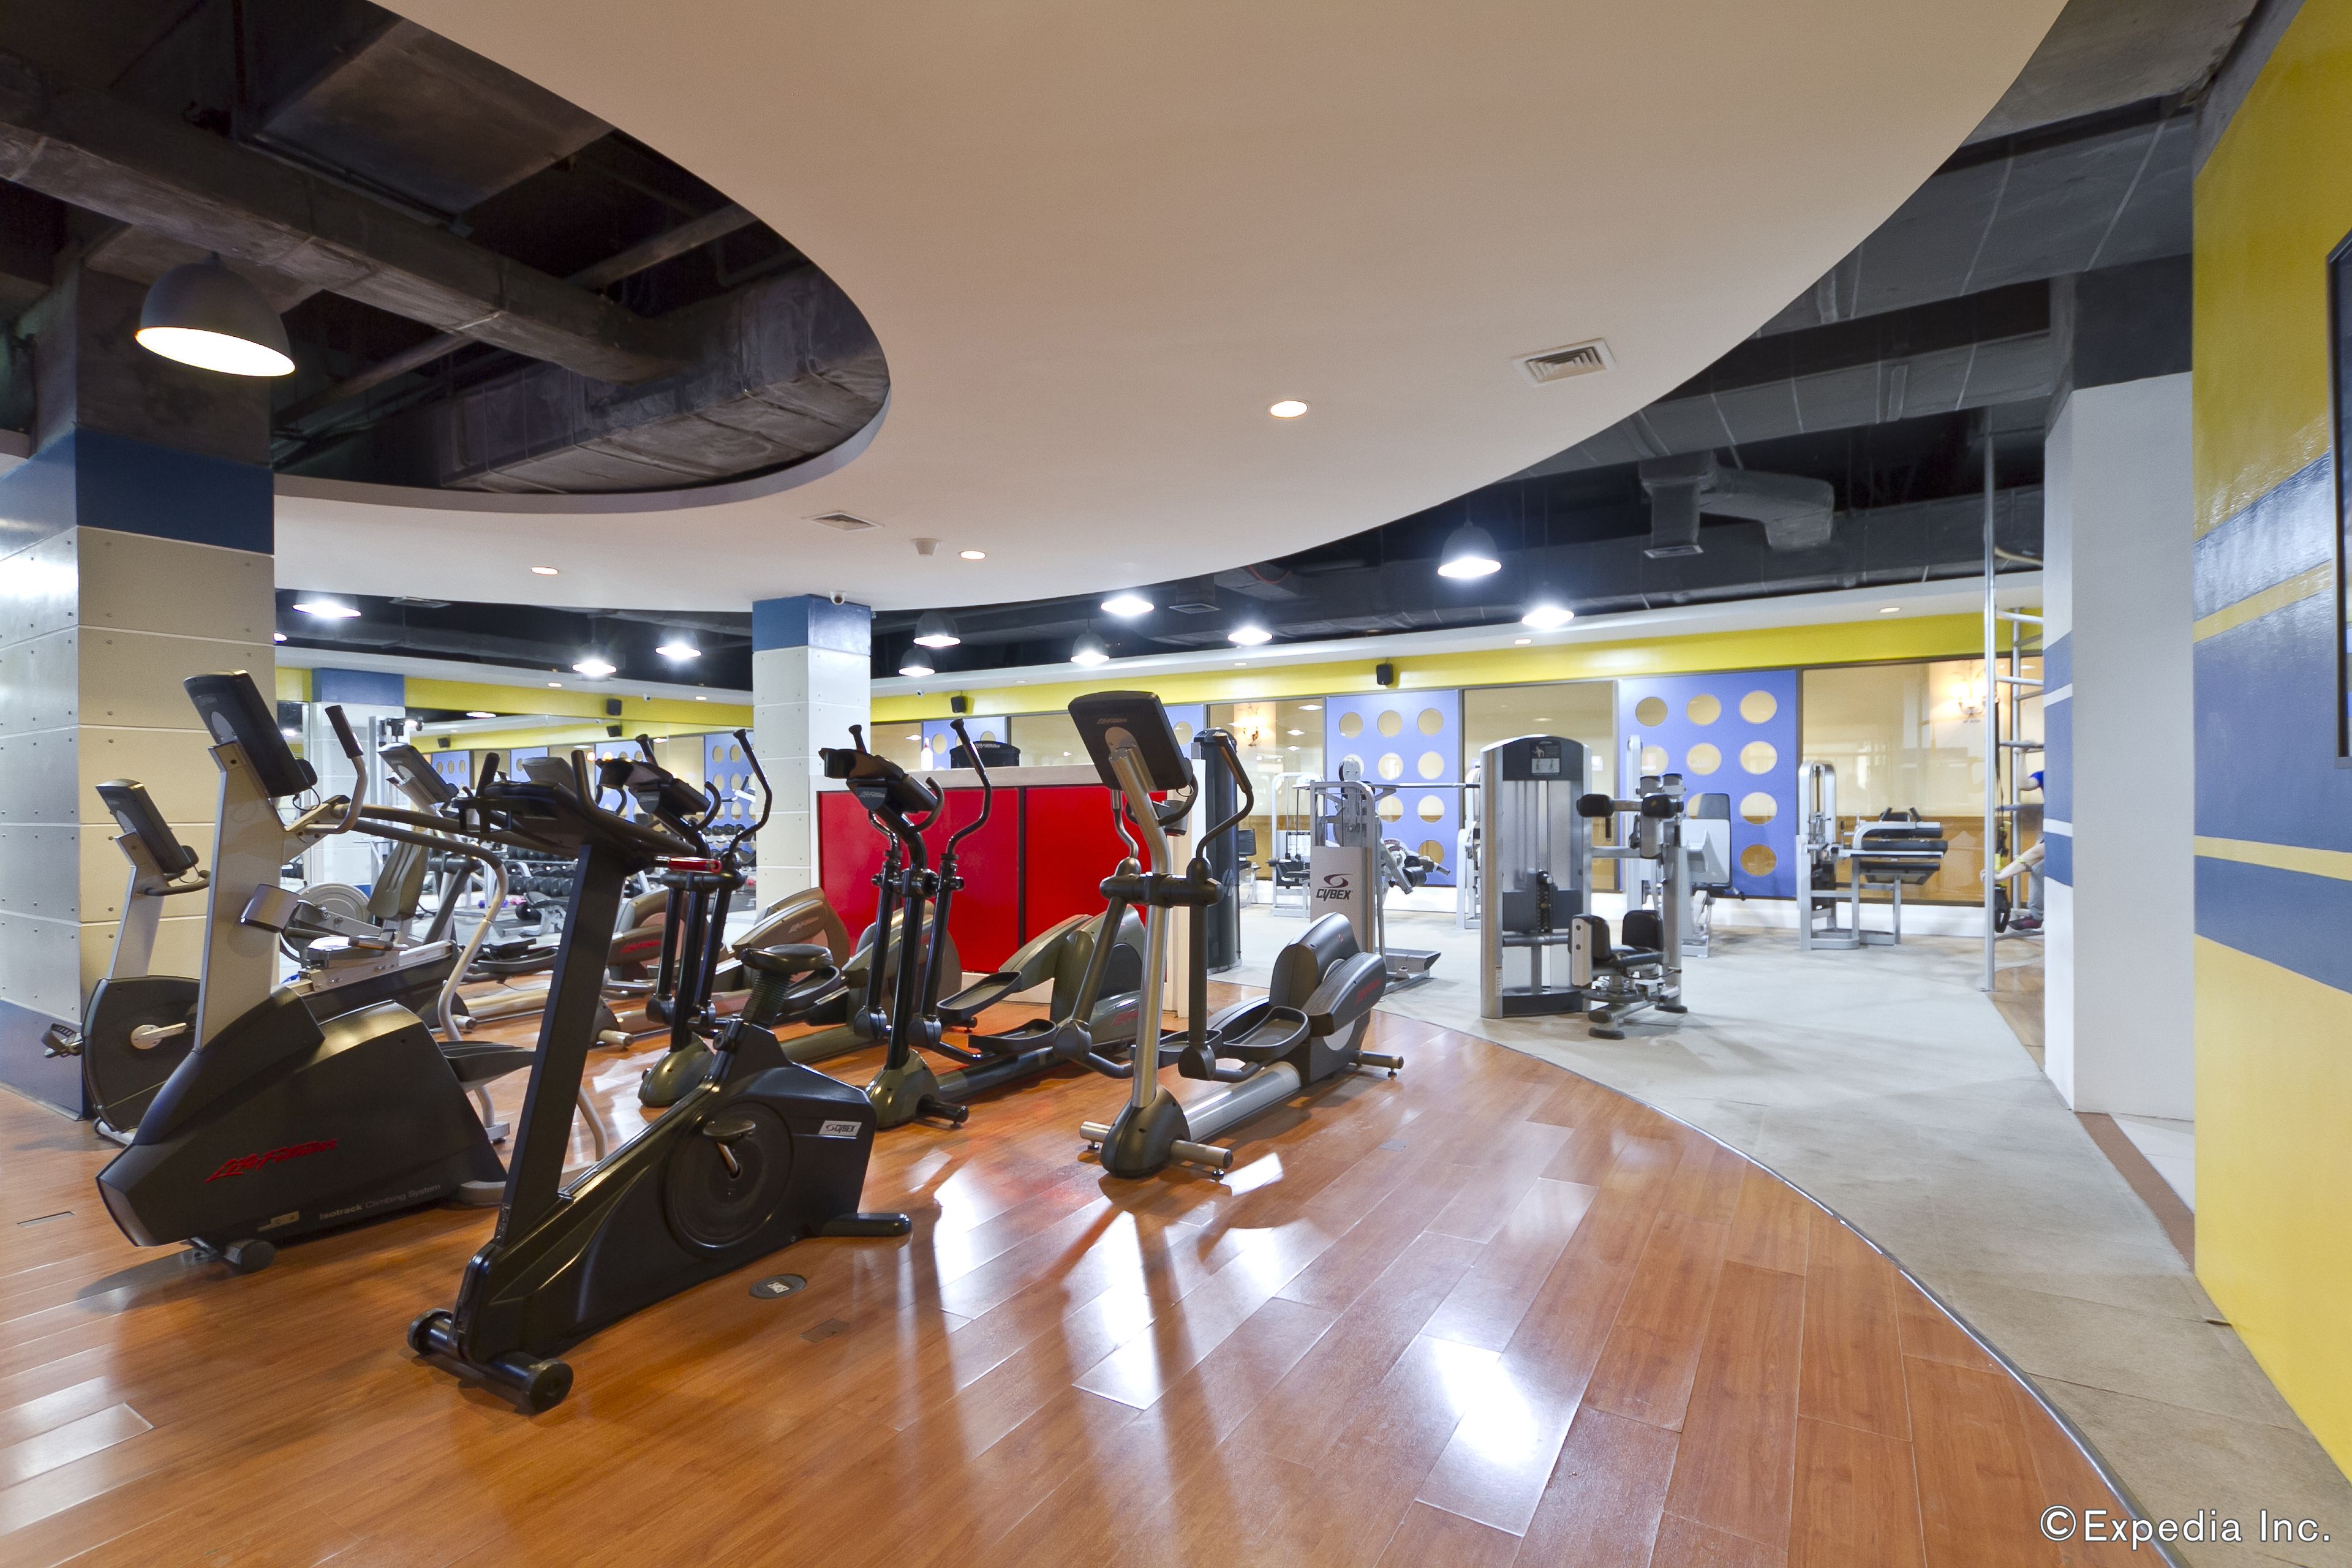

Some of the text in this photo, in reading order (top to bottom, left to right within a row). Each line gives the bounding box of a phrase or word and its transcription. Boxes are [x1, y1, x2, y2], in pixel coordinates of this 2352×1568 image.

[1316, 888, 1352, 902] CYBEX
[319, 1184, 441, 1219] Isotrack Climbing System
